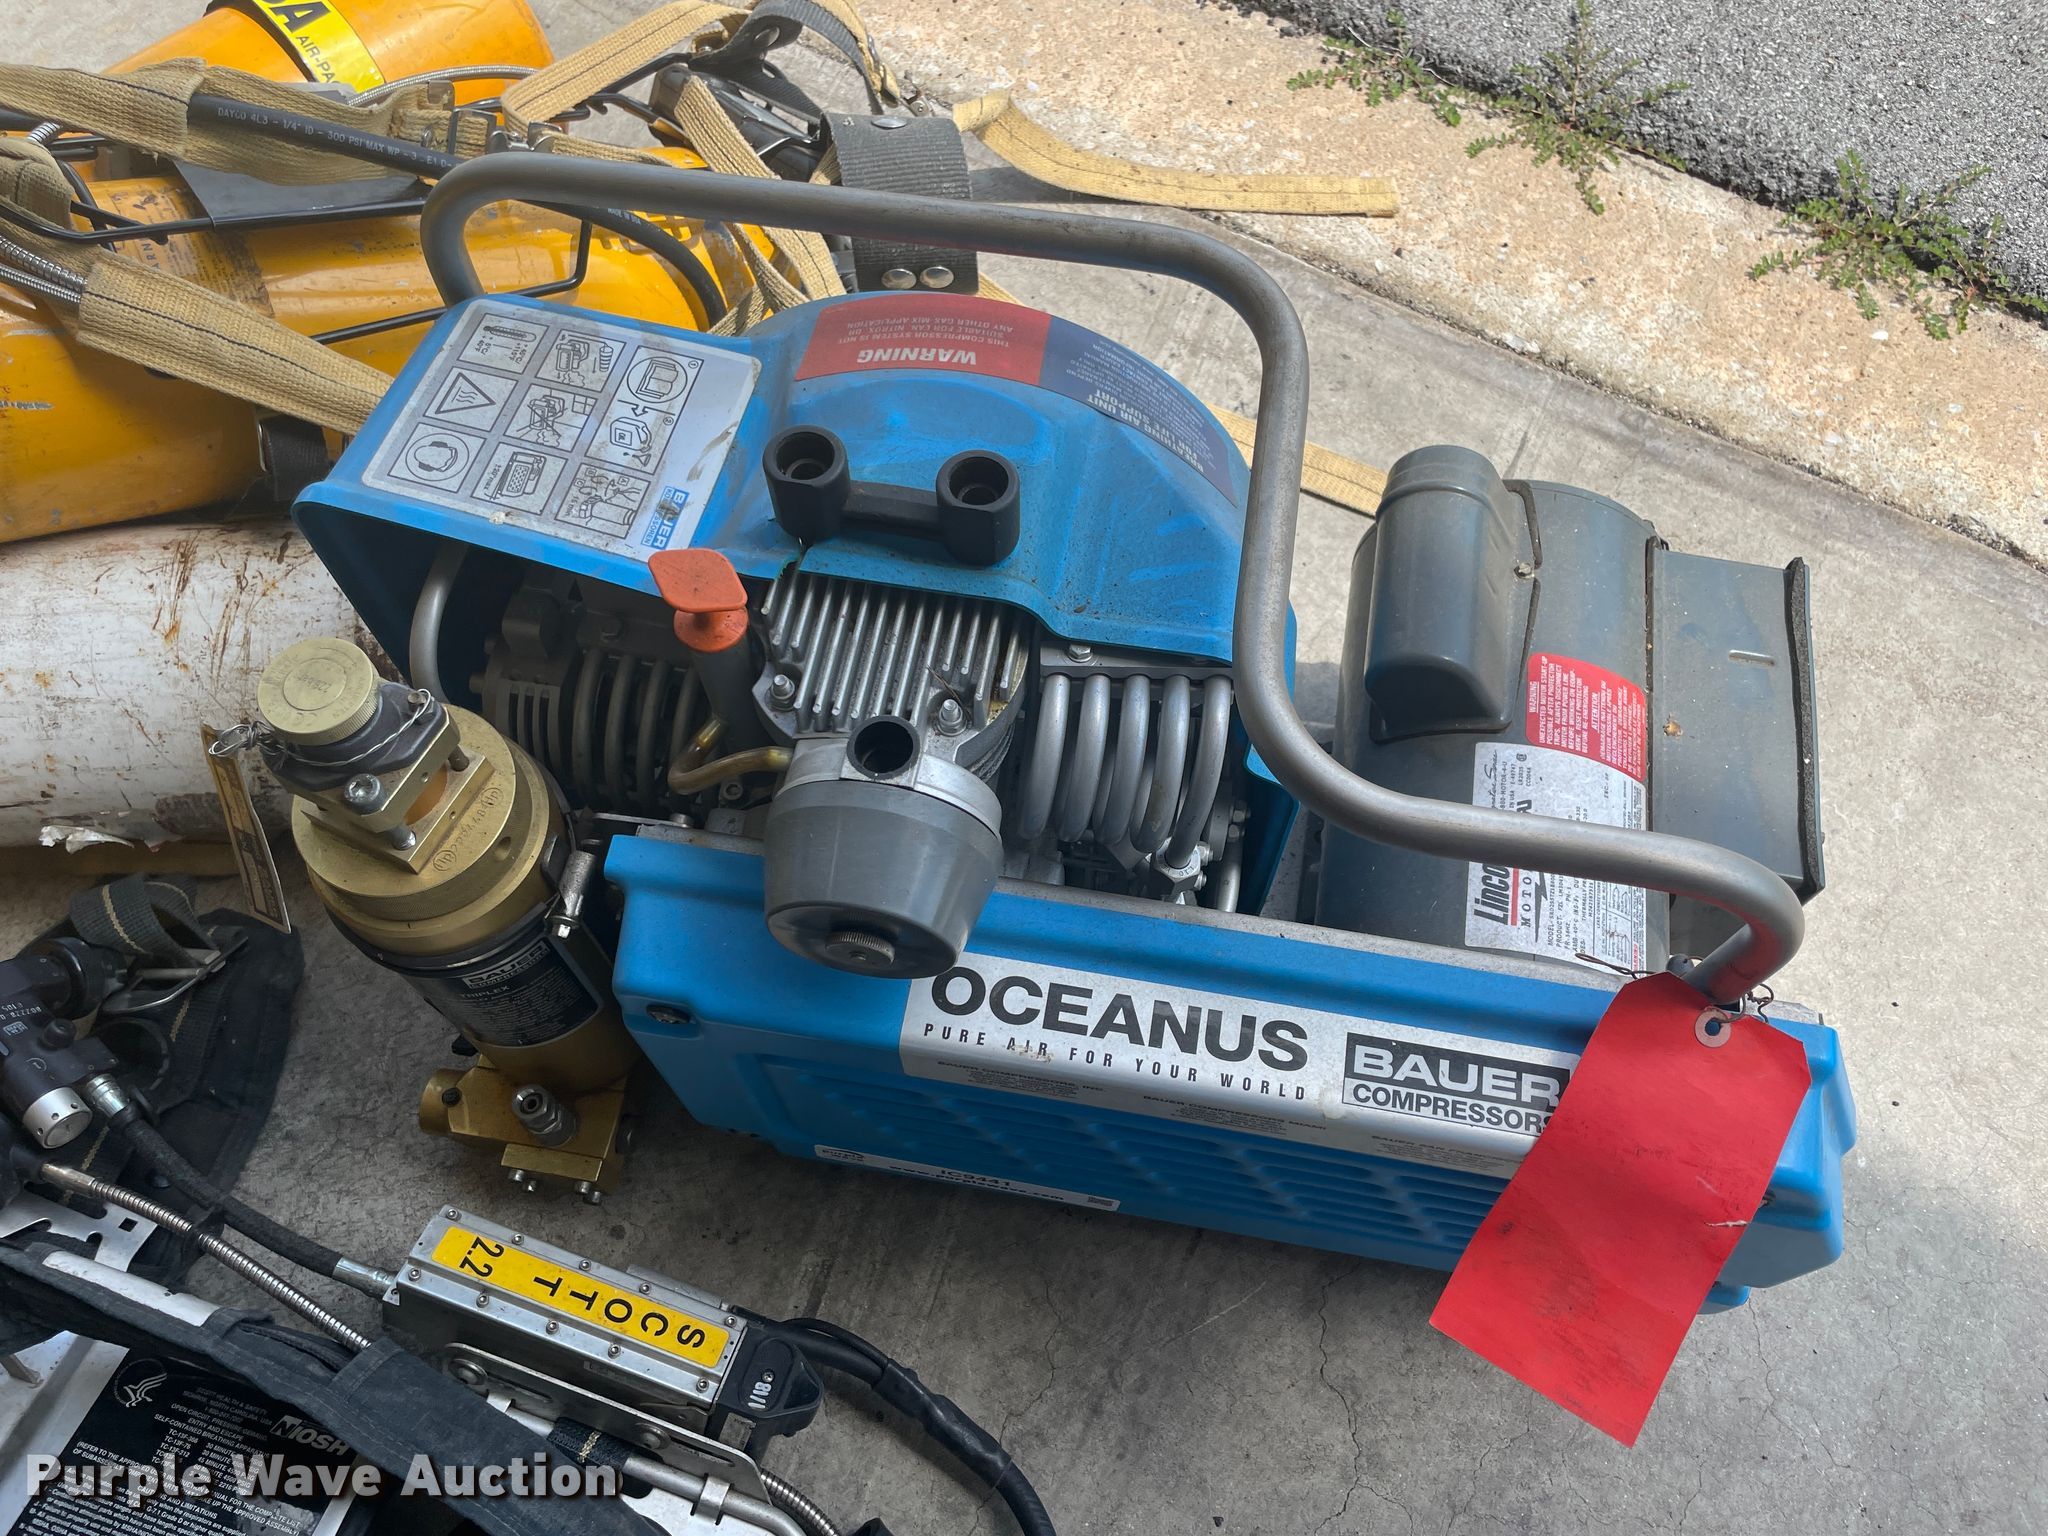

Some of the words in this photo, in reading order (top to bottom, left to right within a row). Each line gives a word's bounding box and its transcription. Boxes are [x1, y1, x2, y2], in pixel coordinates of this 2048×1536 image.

[258, 0, 330, 34] A
[326, 130, 346, 143] 300
[364, 139, 385, 153] MAX
[846, 316, 909, 328] APPLICATION
[871, 331, 912, 339] SYSTEM
[956, 317, 990, 328] OTHER
[913, 330, 984, 343] COMPRESSOR
[856, 348, 977, 365] WARNING
[1085, 393, 1119, 416] UNIT
[1092, 386, 1152, 424] SUPPORT
[1116, 408, 1142, 428] AIR
[1150, 420, 1176, 442] LIFE
[1142, 422, 1207, 473] BREATHING
[1174, 438, 1200, 460] FOR
[1540, 655, 1548, 683] START-UP
[1547, 662, 1555, 695] PROTECTOR
[1554, 663, 1562, 700] DISCONNECT
[1528, 680, 1537, 713] WARNING
[1569, 688, 1575, 697] ON
[1575, 677, 1583, 710] PROTECTOR
[1538, 705, 1546, 743] UNEXPECTED
[1474, 863, 1510, 925] Linco
[1518, 876, 1535, 927] MOTO
[931, 965, 1310, 1073] OCEANUS
[923, 1023, 986, 1047] PURE
[1006, 1036, 1049, 1059] AIR
[1069, 1046, 1114, 1069] FOR
[1135, 1056, 1199, 1082] YOUR
[1220, 1072, 1307, 1102] WORLD
[1353, 1045, 1566, 1110] BAUER
[459, 1235, 504, 1279] 2.2
[533, 1275, 706, 1351] SCOTT
[170, 1403, 187, 1413] OPEN
[154, 1413, 201, 1435] SELF-CONTAINED
[201, 1430, 235, 1446] BREATHING
[187, 1417, 207, 1428] ENTRY
[206, 1424, 220, 1433] AND
[220, 1428, 244, 1441] ESCAPE
[270, 1413, 349, 1456] NIOSH
[204, 1459, 227, 1471] MINUTE
[209, 1452, 231, 1464] MINUTE
[213, 1445, 235, 1457] MINUTE
[76, 1440, 98, 1453] (REFER
[97, 1448, 107, 1456] TO
[106, 1451, 119, 1461] THE
[228, 1496, 242, 1506] FOR
[240, 1500, 256, 1512] THE
[285, 1517, 302, 1529] LIST
[236, 1478, 250, 1488] PSIG
[40, 1502, 61, 1514] Failure
[65, 1513, 90, 1526] properly
[89, 1521, 100, 1529] use
[100, 1525, 112, 1533] and
[78, 1508, 113, 1525] atmospheres
[112, 1520, 121, 1528] by
[97, 1505, 113, 1516] parts
[112, 1511, 129, 1521] which
[128, 1517, 142, 1527] have
[141, 1522, 153, 1531] not
[151, 1526, 166, 1535] been
[112, 1502, 131, 1514] ranges
[130, 1509, 143, 1518] and
[142, 1513, 157, 1523] hose
[155, 1518, 177, 1531] lengths
[158, 1501, 173, 1511] when
[172, 1506, 183, 1515] the
[182, 1510, 212, 1527] respirators
[212, 1521, 222, 1529] are
[166, 1496, 180, 1505] AND
[180, 1500, 218, 1519] LIMITATIONS
[210, 1499, 221, 1508] UP
[220, 1502, 234, 1512] THE
[233, 1507, 266, 1524] APPROVED
[159, 1510, 178, 1522] Grade
[189, 1522, 208, 1534] higher
